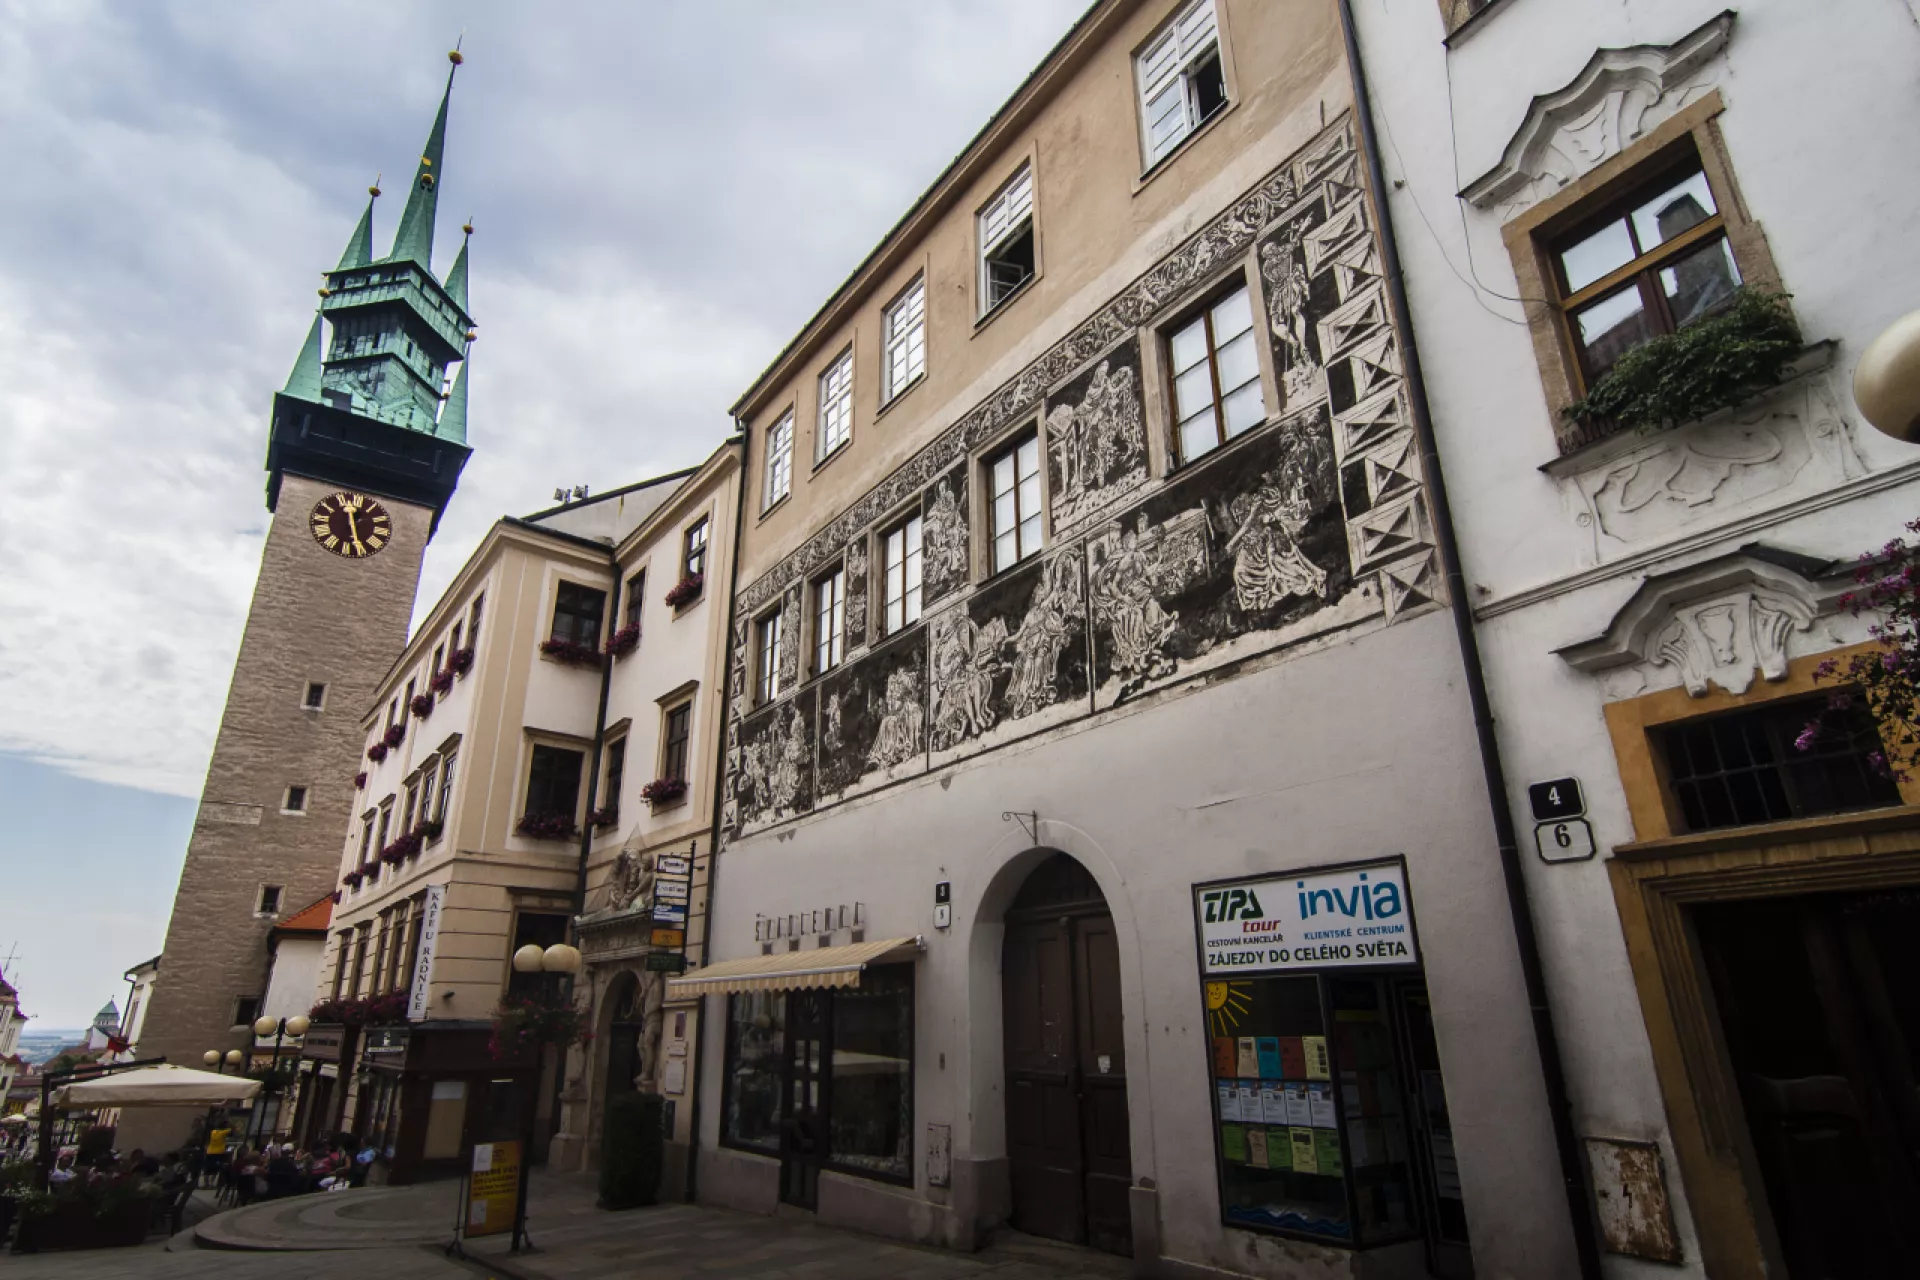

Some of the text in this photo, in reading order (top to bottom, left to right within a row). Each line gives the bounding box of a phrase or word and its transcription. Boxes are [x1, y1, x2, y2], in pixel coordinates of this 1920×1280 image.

[1549, 786, 1561, 805] 4
[1554, 824, 1571, 848] 6
[1203, 888, 1264, 923] TIPA
[1297, 873, 1402, 921] invia
[1242, 919, 1281, 933] tour
[1304, 924, 1405, 940] KLIENTSKÉ CENTRUM
[414, 892, 440, 1011] KAFE U RADNICE
[1207, 933, 1284, 948] CESTOVNÍ KANCELÁŘ
[1208, 940, 1408, 966] ZÁJEZDY DO CELÉHO SVĚTA
